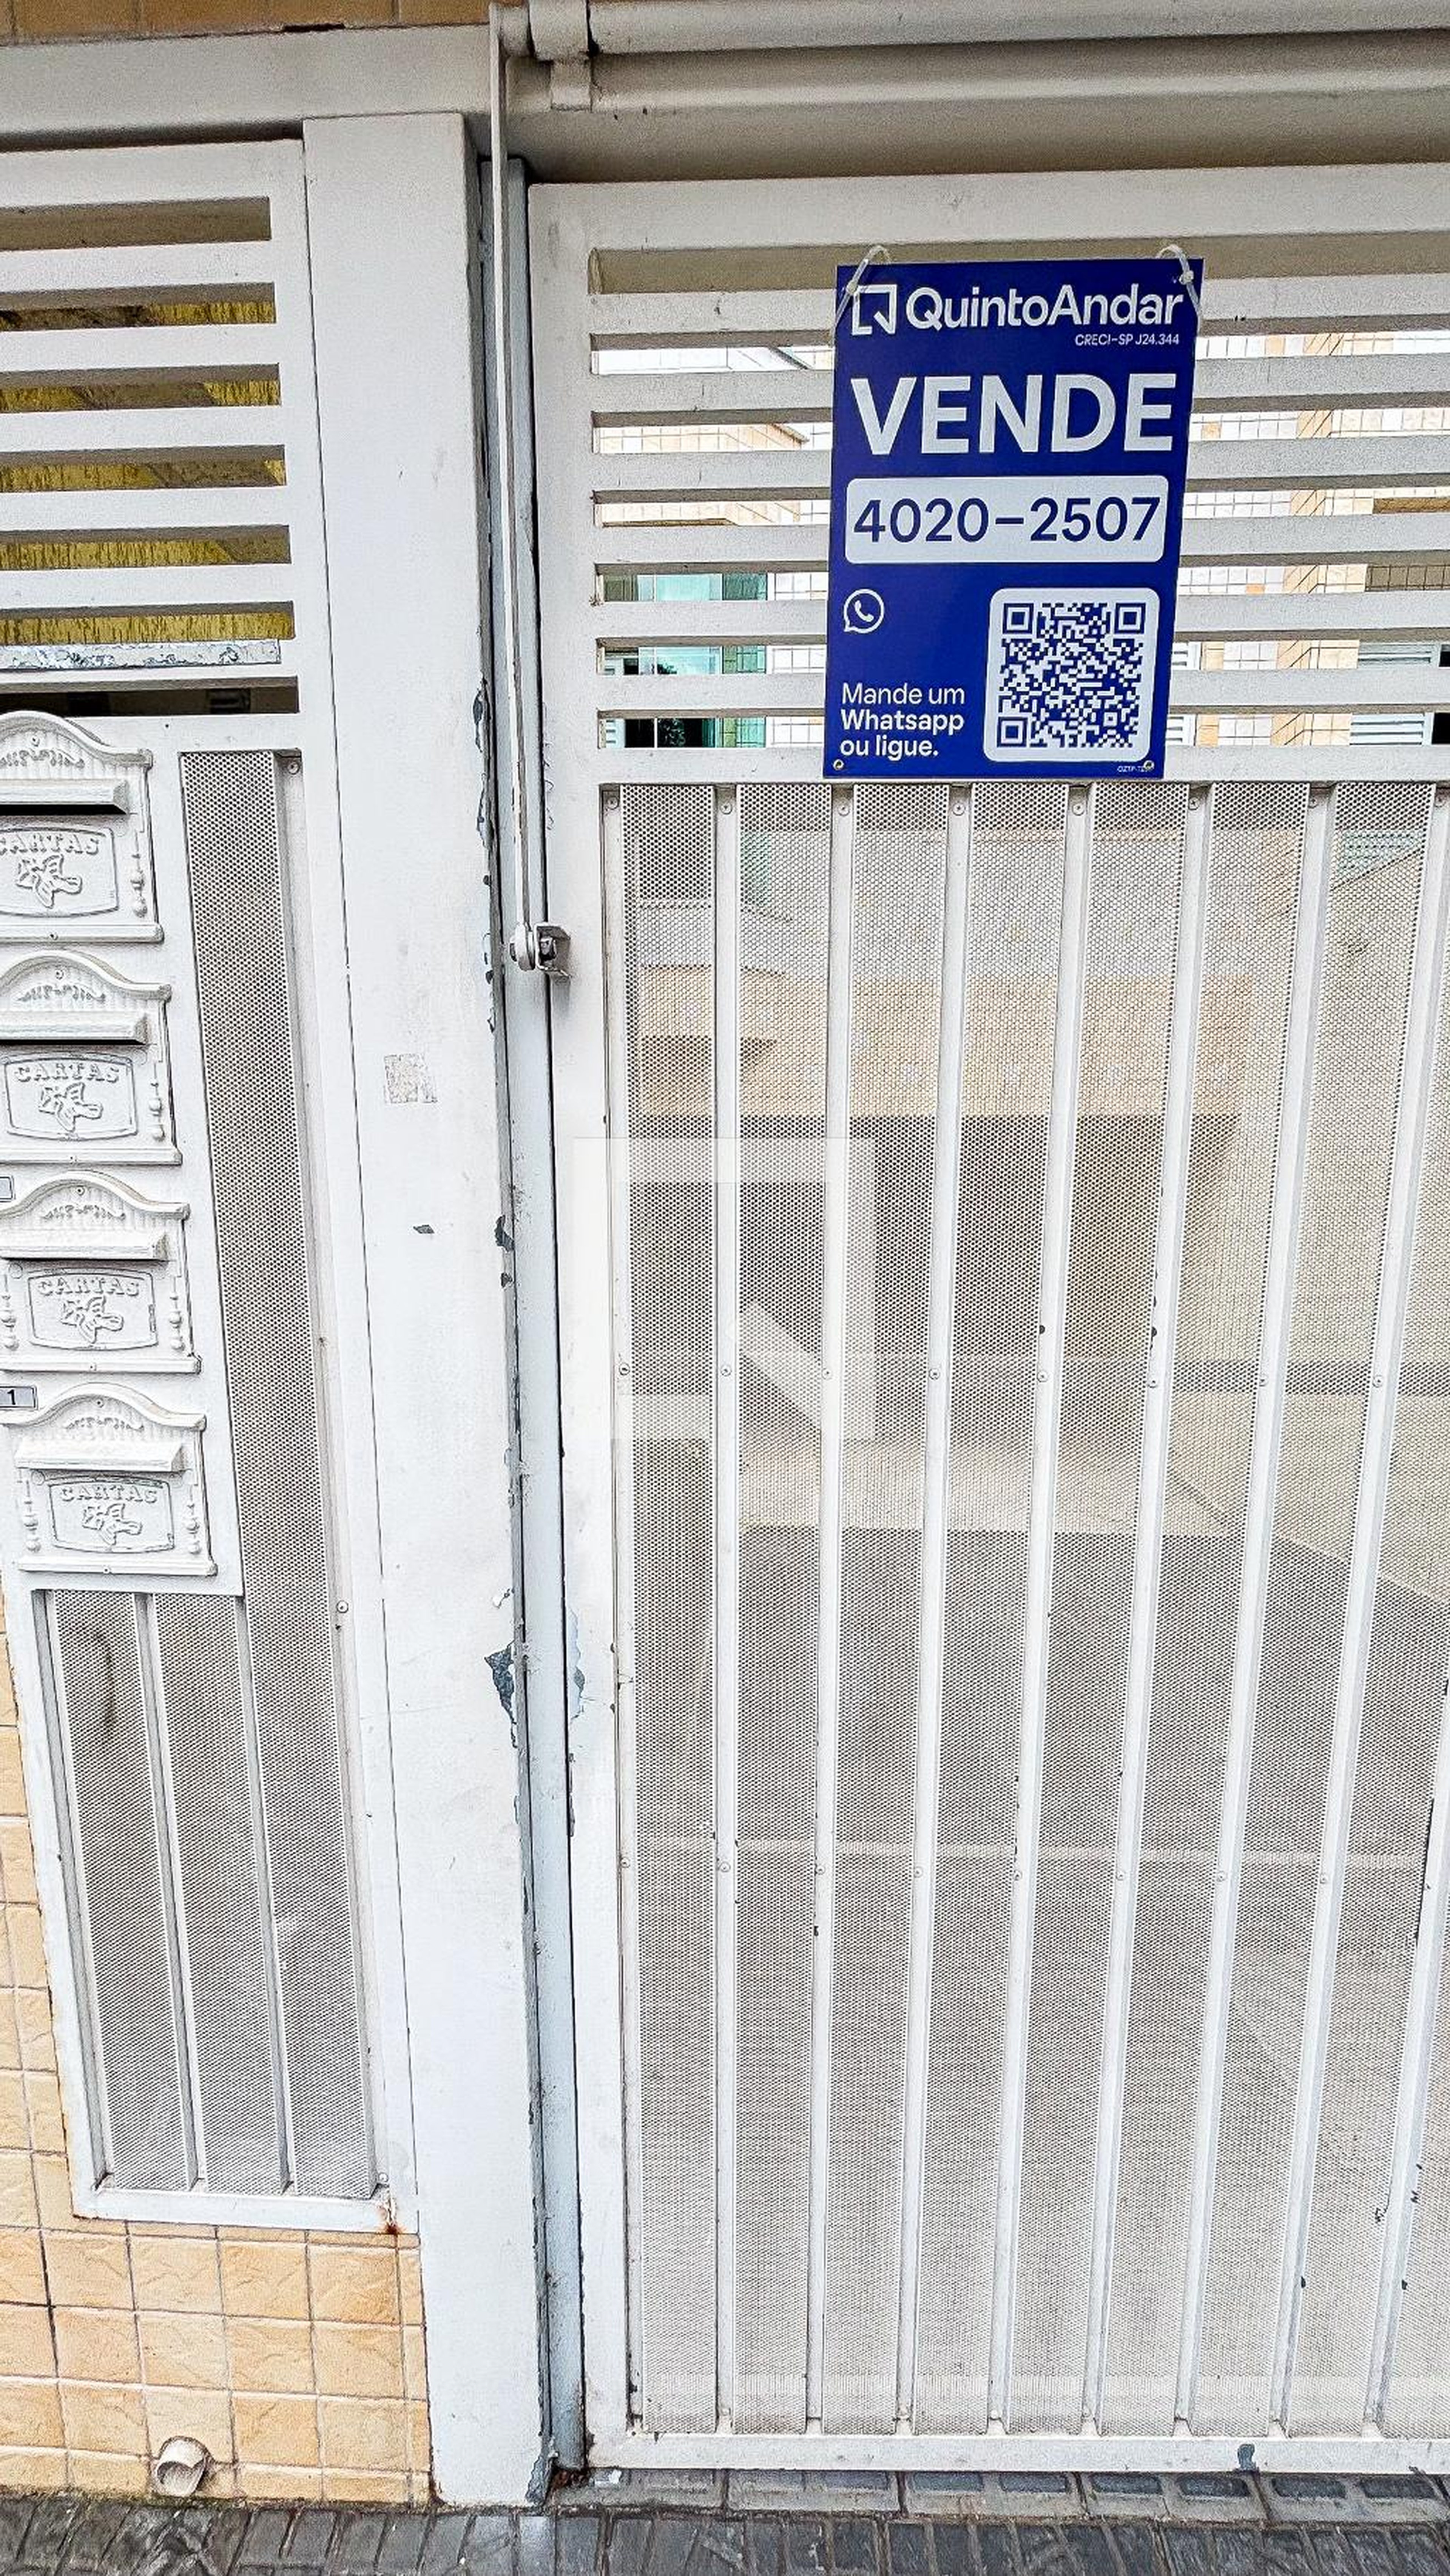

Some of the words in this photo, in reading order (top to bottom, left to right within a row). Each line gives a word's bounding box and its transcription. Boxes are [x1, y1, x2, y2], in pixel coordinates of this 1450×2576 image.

[906, 283, 1183, 331] QuintoAndar
[1075, 333, 1133, 346] CRECI-SP
[1135, 333, 1179, 345] J24.344
[851, 373, 1176, 455] VENDE
[854, 497, 1160, 542] 4020-2507
[842, 682, 922, 704] Mande
[929, 688, 965, 704] um
[841, 709, 964, 735] Whatsapp
[840, 740, 869, 756] ou
[875, 735, 938, 761] ligue.
[38, 1277, 139, 1296] CARTAS
[7, 1389, 15, 1405] 1
[60, 1485, 157, 1503] CARTAS
